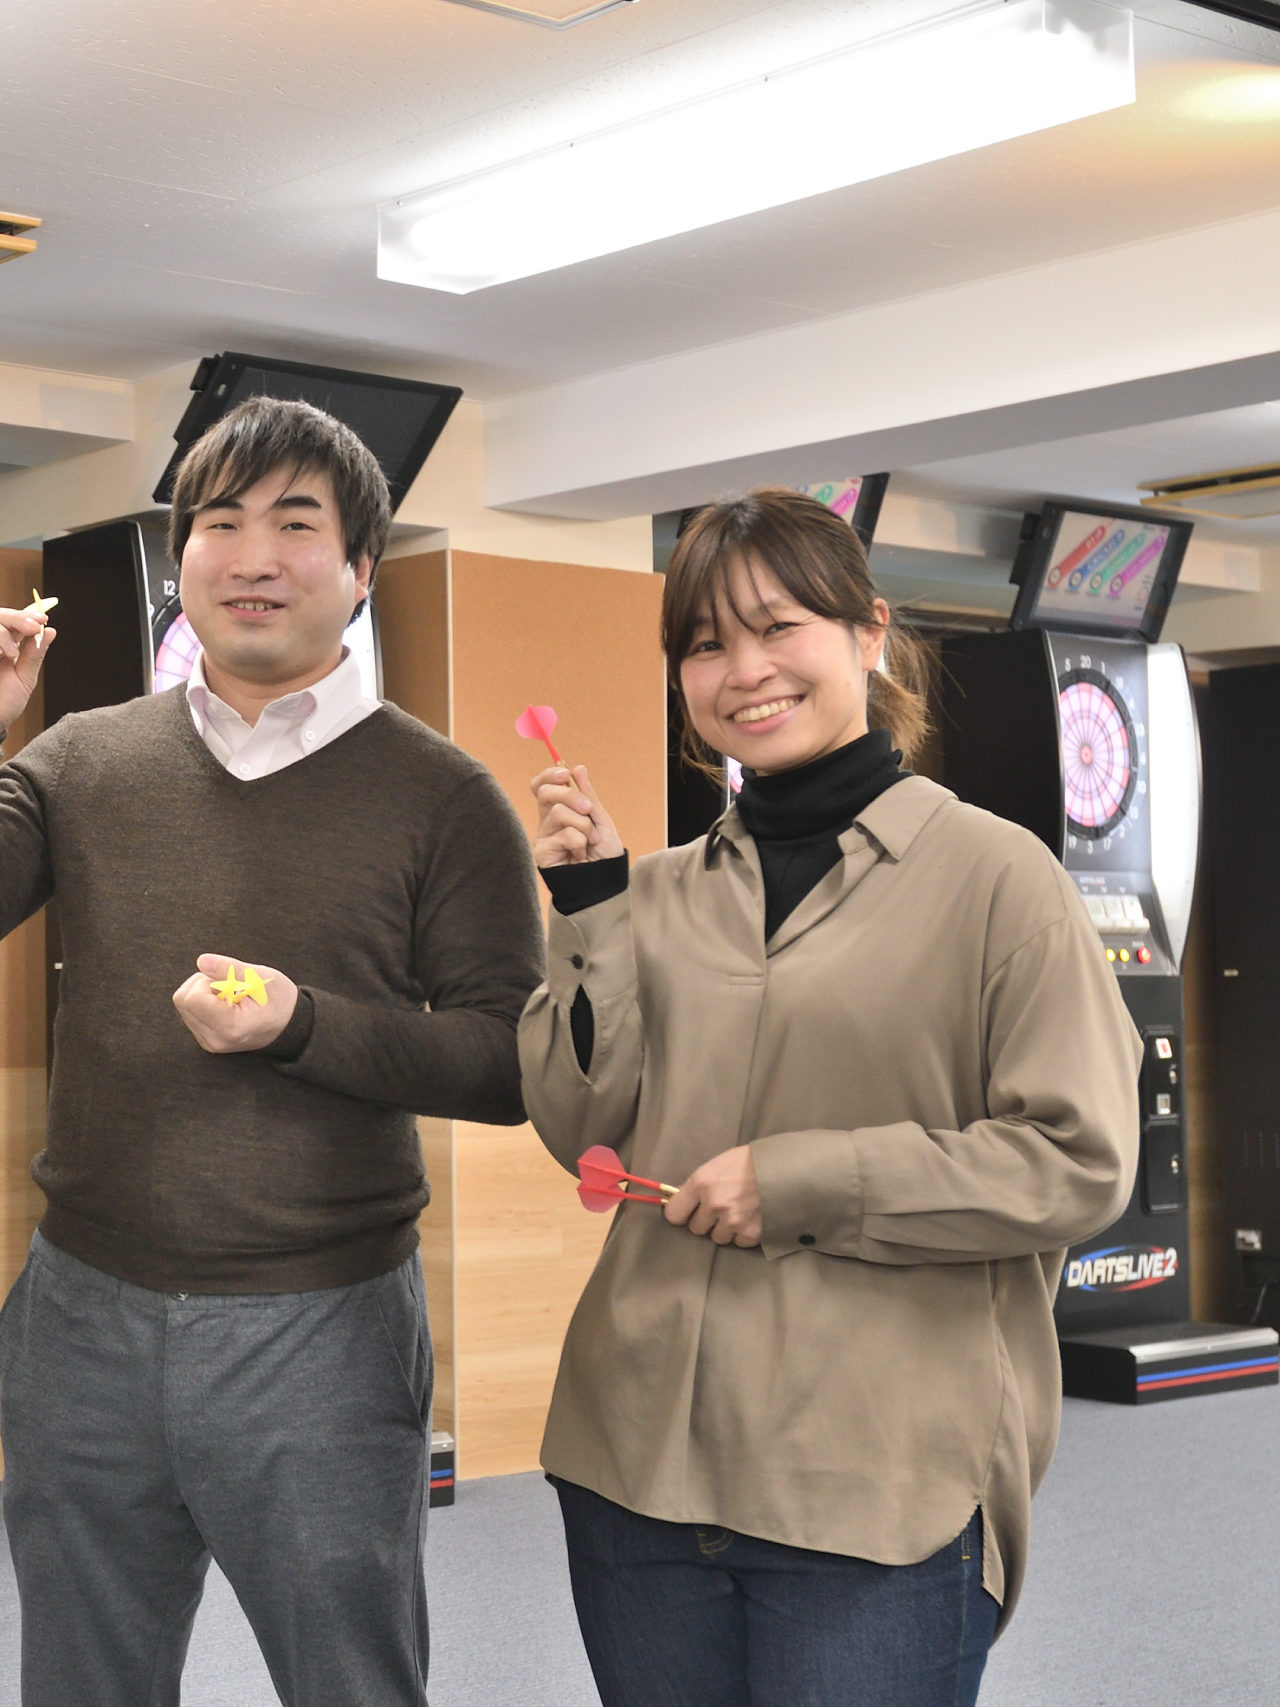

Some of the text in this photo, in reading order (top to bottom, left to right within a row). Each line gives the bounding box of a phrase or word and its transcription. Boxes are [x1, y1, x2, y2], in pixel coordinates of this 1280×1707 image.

[163, 580, 176, 596] 12
[1080, 655, 1092, 669] 20
[1067, 1247, 1177, 1288] DARTSLIVE2
